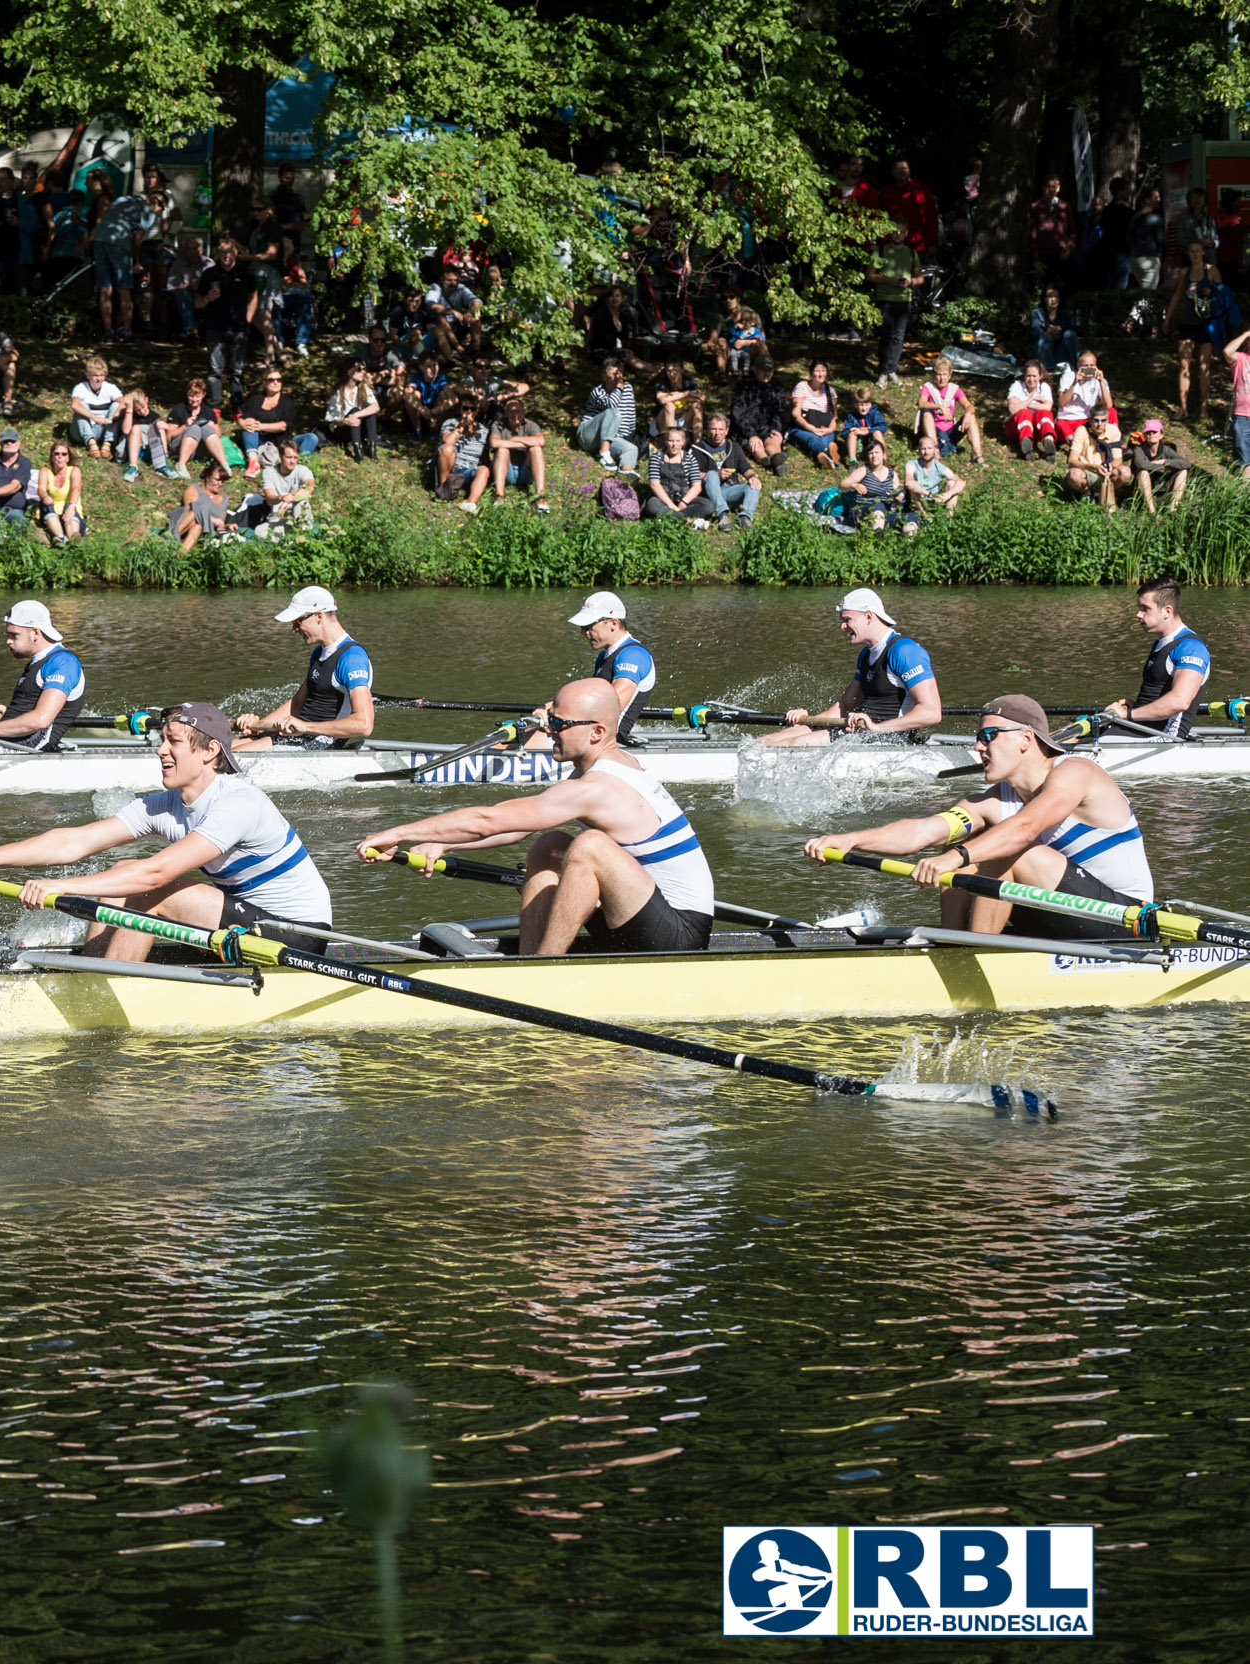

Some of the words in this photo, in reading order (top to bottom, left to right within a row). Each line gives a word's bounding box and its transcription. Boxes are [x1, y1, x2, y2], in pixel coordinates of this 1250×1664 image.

[414, 752, 558, 782] MINDEN
[1000, 882, 1124, 917] HACKEROTT.de
[97, 908, 207, 947] HACKEROTT.de
[1206, 932, 1237, 946] STARK.
[288, 957, 317, 971] STARK.
[317, 964, 357, 980] SCHNELL.
[357, 973, 378, 985] GUT.
[387, 979, 404, 990] RBL
